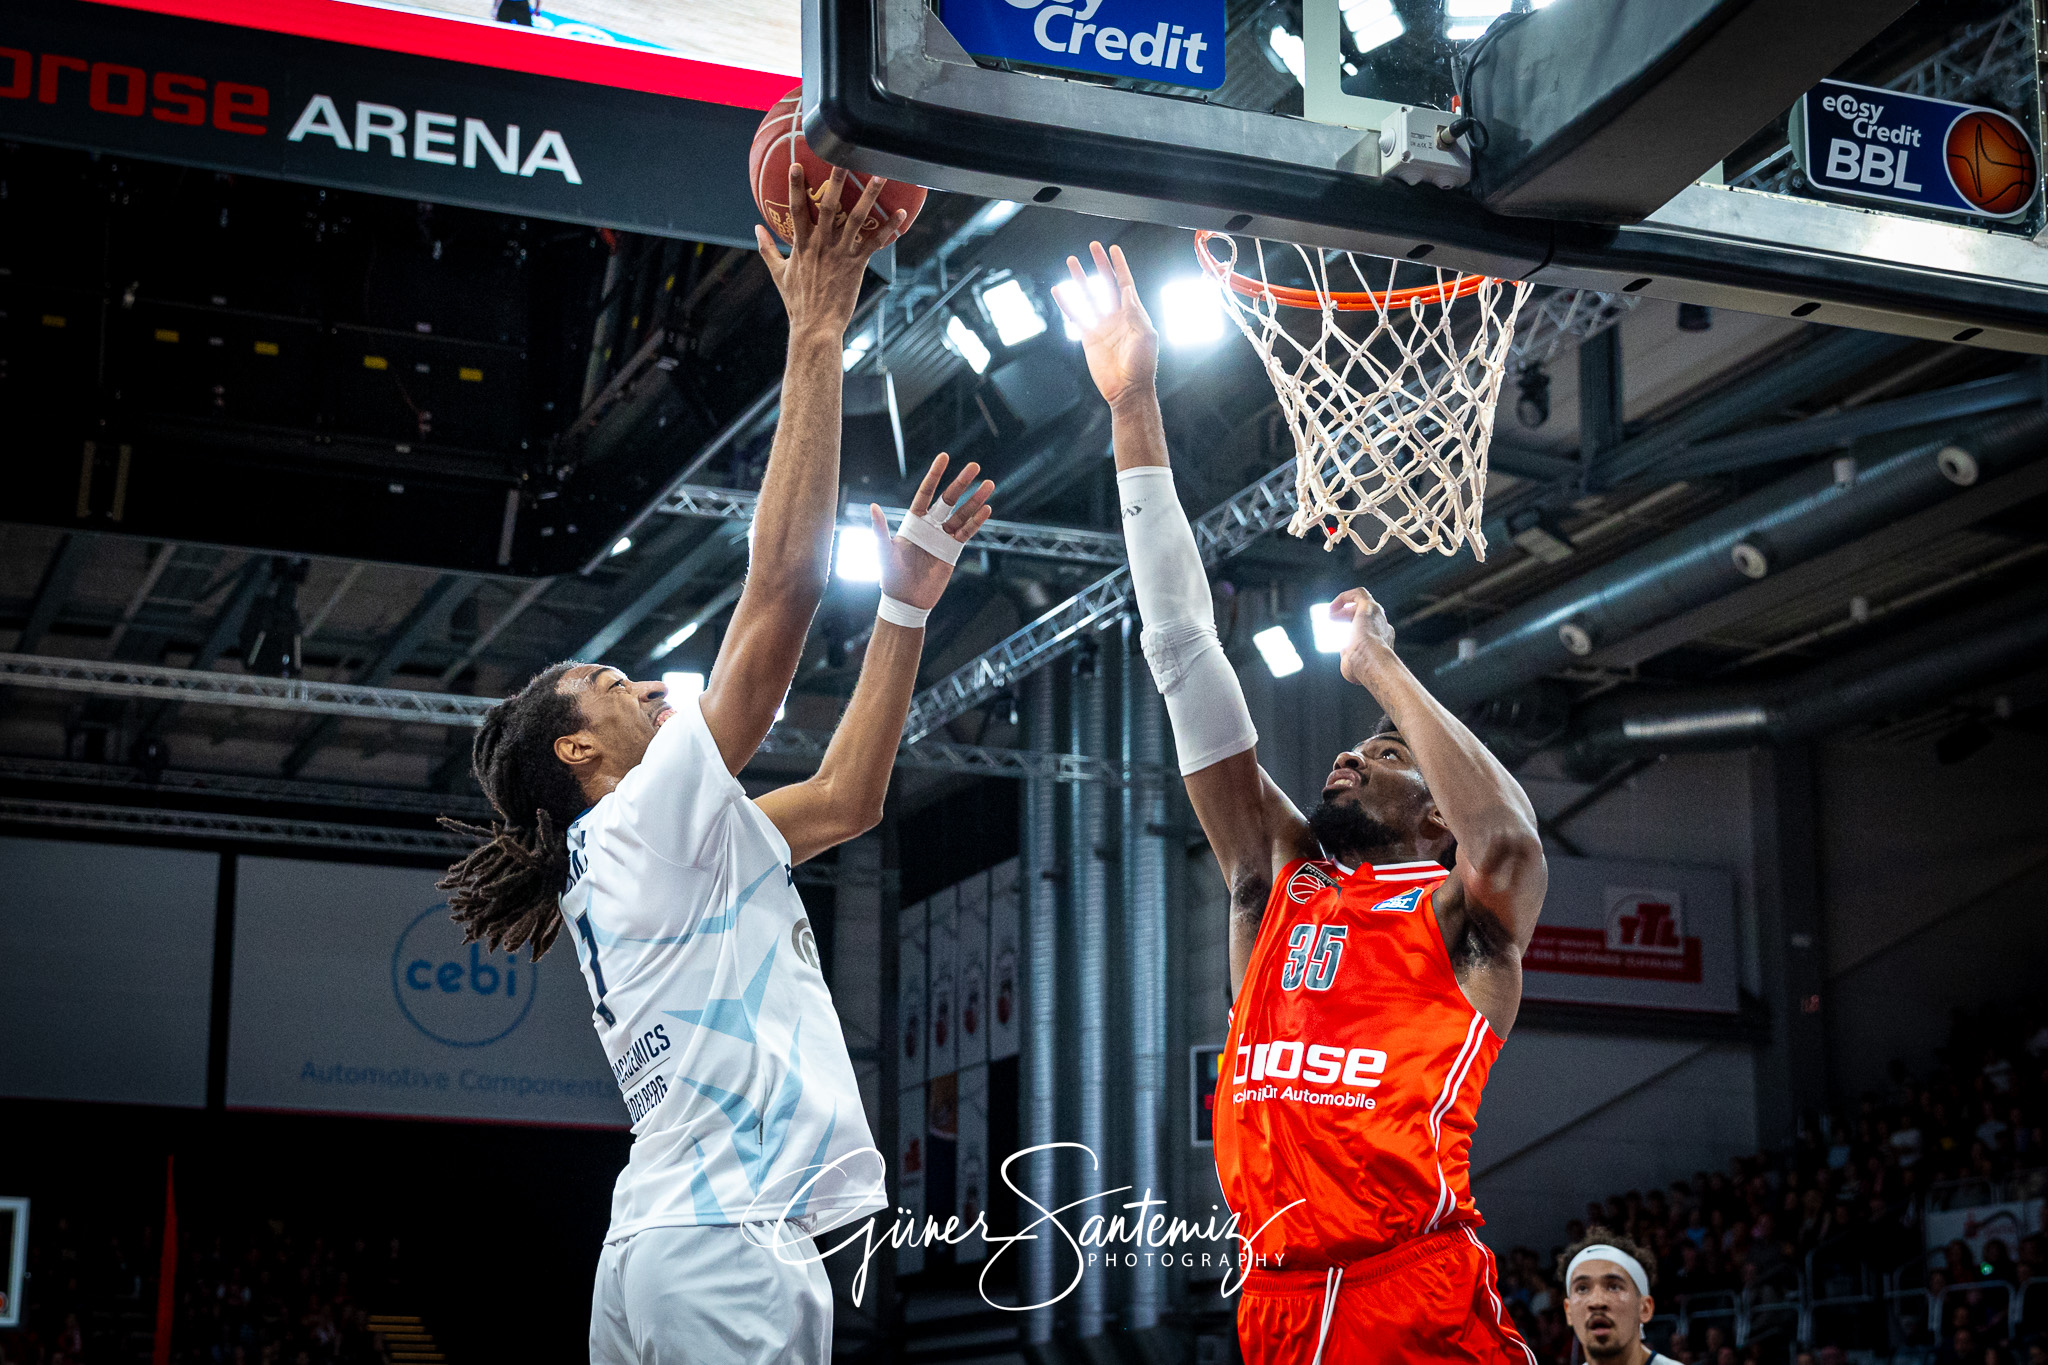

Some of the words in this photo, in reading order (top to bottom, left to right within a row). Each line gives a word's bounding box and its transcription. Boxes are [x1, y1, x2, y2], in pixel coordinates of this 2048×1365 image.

[1033, 4, 1208, 74] Credit
[287, 94, 583, 185] ARENA
[1852, 118, 1922, 148] Credit
[1825, 138, 1922, 193] BBL
[406, 942, 517, 998] cebi
[1281, 923, 1349, 992] 35
[300, 1061, 450, 1091] Automotive
[1280, 1085, 1377, 1110] Automobile
